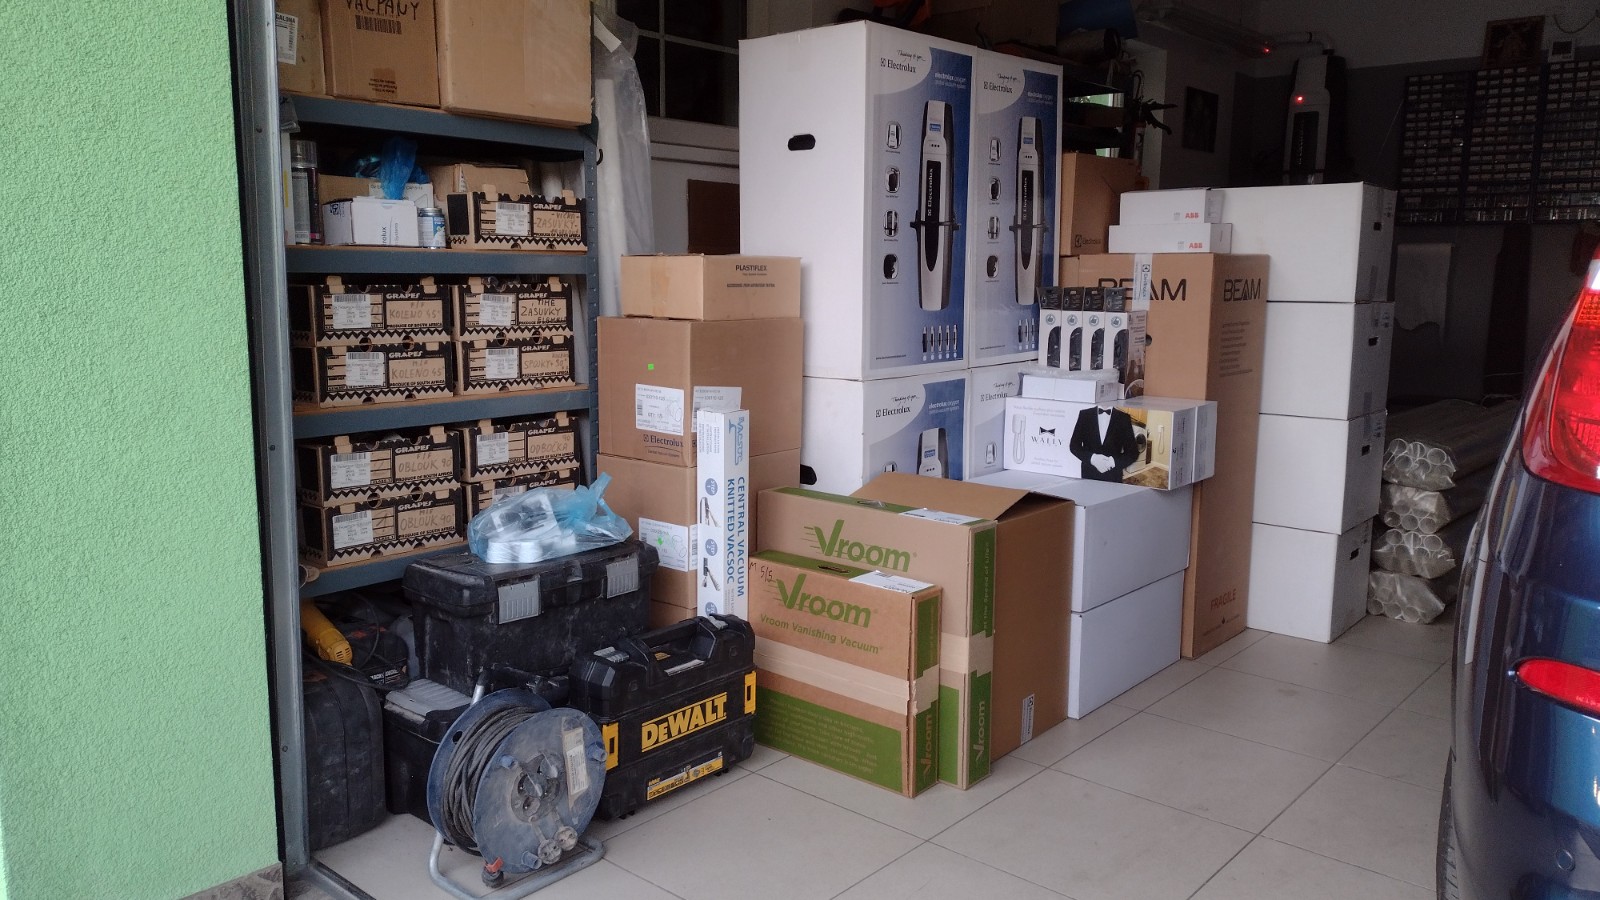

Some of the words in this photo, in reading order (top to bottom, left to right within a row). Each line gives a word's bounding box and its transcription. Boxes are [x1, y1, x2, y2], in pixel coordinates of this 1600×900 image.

[887, 59, 917, 73] Electrolux
[988, 82, 1013, 93] Electrolux
[735, 264, 767, 272] PLASTIFLEX
[385, 292, 420, 300] GRAPES
[1223, 278, 1262, 301] BEAM
[388, 350, 423, 358] GRAPES
[521, 344, 551, 352] GRAPES
[882, 405, 911, 417] Electrolux
[527, 426, 557, 436] GRAPES
[650, 434, 684, 448] Electrolux
[1031, 434, 1063, 447] WALLY
[394, 444, 431, 454] GRAPES
[529, 478, 557, 488] GRAPES
[397, 500, 434, 511] GRAPES
[727, 478, 735, 532] KNITTED
[737, 476, 745, 537] CENTRAL
[813, 519, 911, 573] Vroom
[727, 534, 735, 585] VACSOC
[737, 539, 745, 597] VACUUM
[776, 573, 871, 629] Vroom
[760, 613, 789, 630] Vroom
[792, 622, 837, 644] Vanishing
[840, 635, 879, 654] Vacuum
[975, 701, 985, 764] Vroom
[921, 714, 932, 771] Vroom
